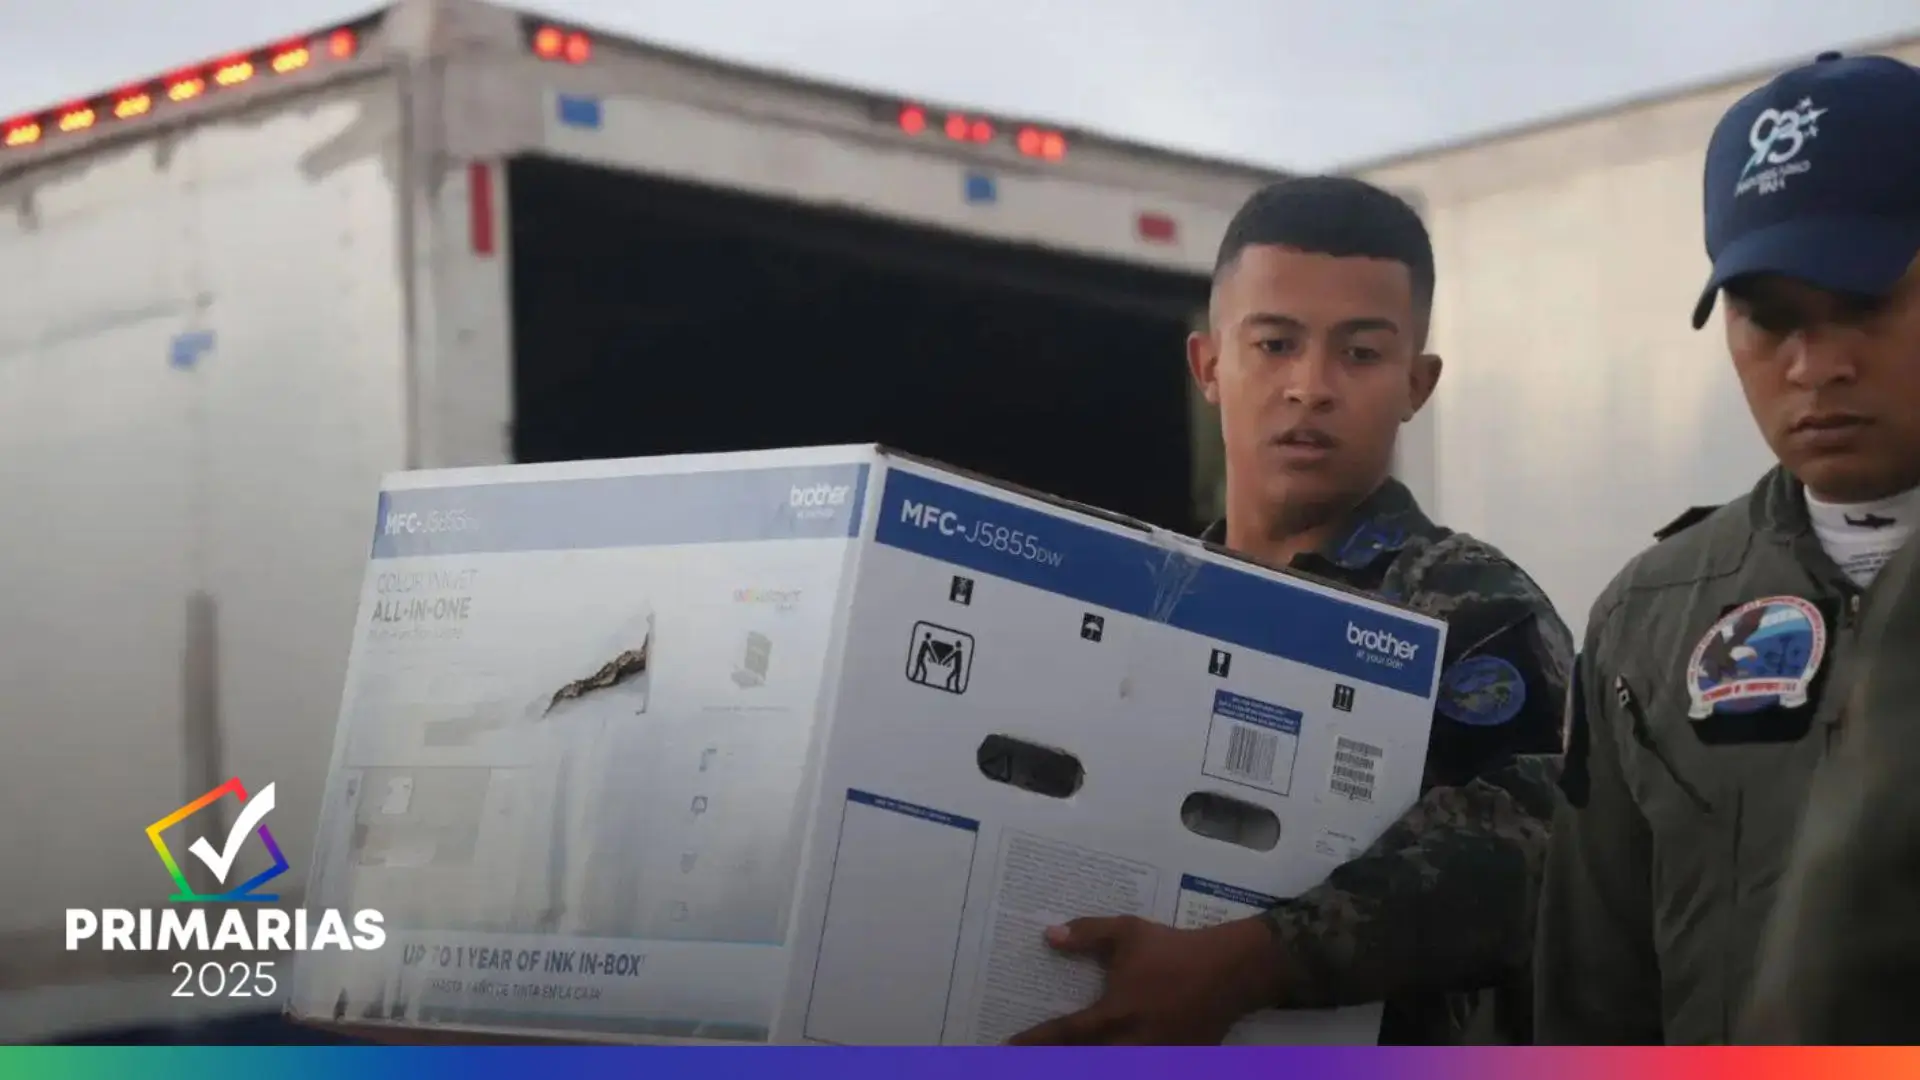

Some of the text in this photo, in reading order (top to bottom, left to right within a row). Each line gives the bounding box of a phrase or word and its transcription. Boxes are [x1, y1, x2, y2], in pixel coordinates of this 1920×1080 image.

[1745, 108, 1805, 165] 93
[790, 484, 850, 507] brother
[901, 499, 1065, 568] MFC-J5855DW
[370, 596, 472, 622] ALL-IN-ONE
[1346, 620, 1419, 661] brother
[468, 946, 512, 970] YEAR
[516, 949, 542, 972] OF
[544, 950, 577, 974] INK
